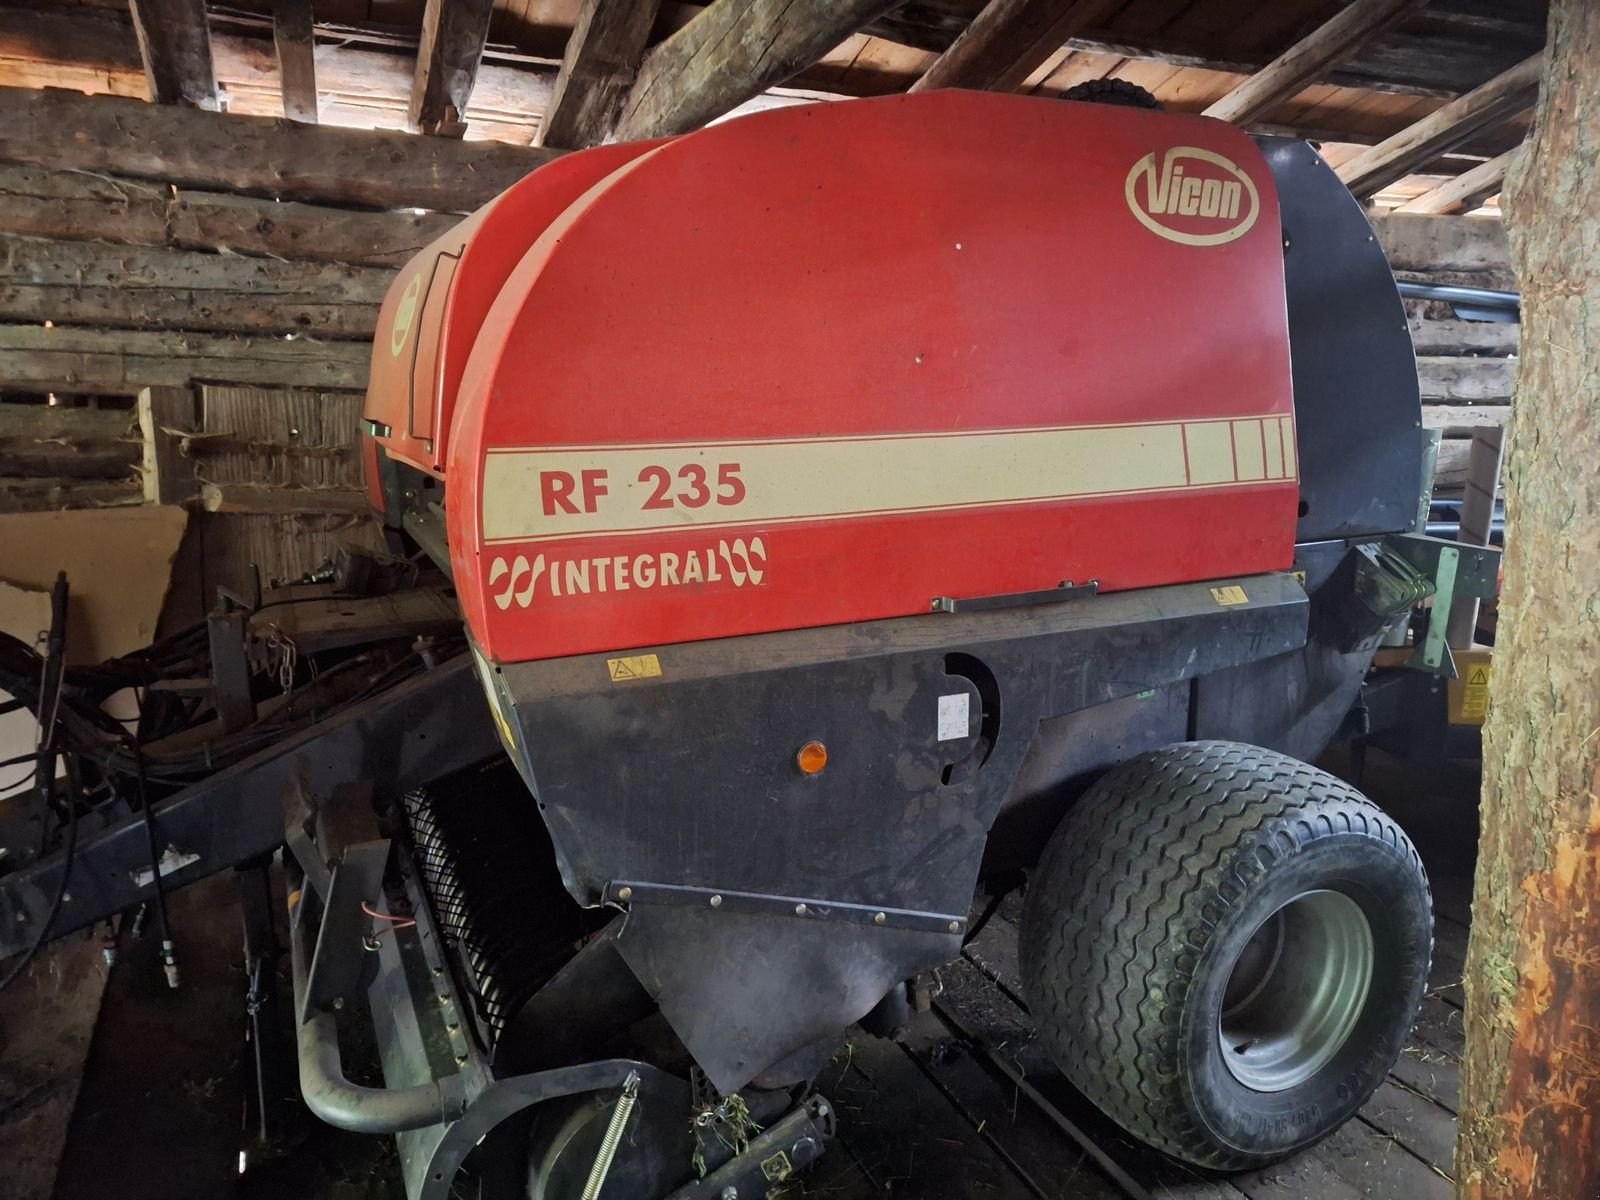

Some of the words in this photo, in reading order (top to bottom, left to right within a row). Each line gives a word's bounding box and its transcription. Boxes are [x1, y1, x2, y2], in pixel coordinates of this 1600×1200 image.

[1146, 147, 1243, 219] Vicon
[540, 469, 609, 516] RF
[637, 463, 747, 511] 235
[550, 548, 722, 597] INTEGRAL
